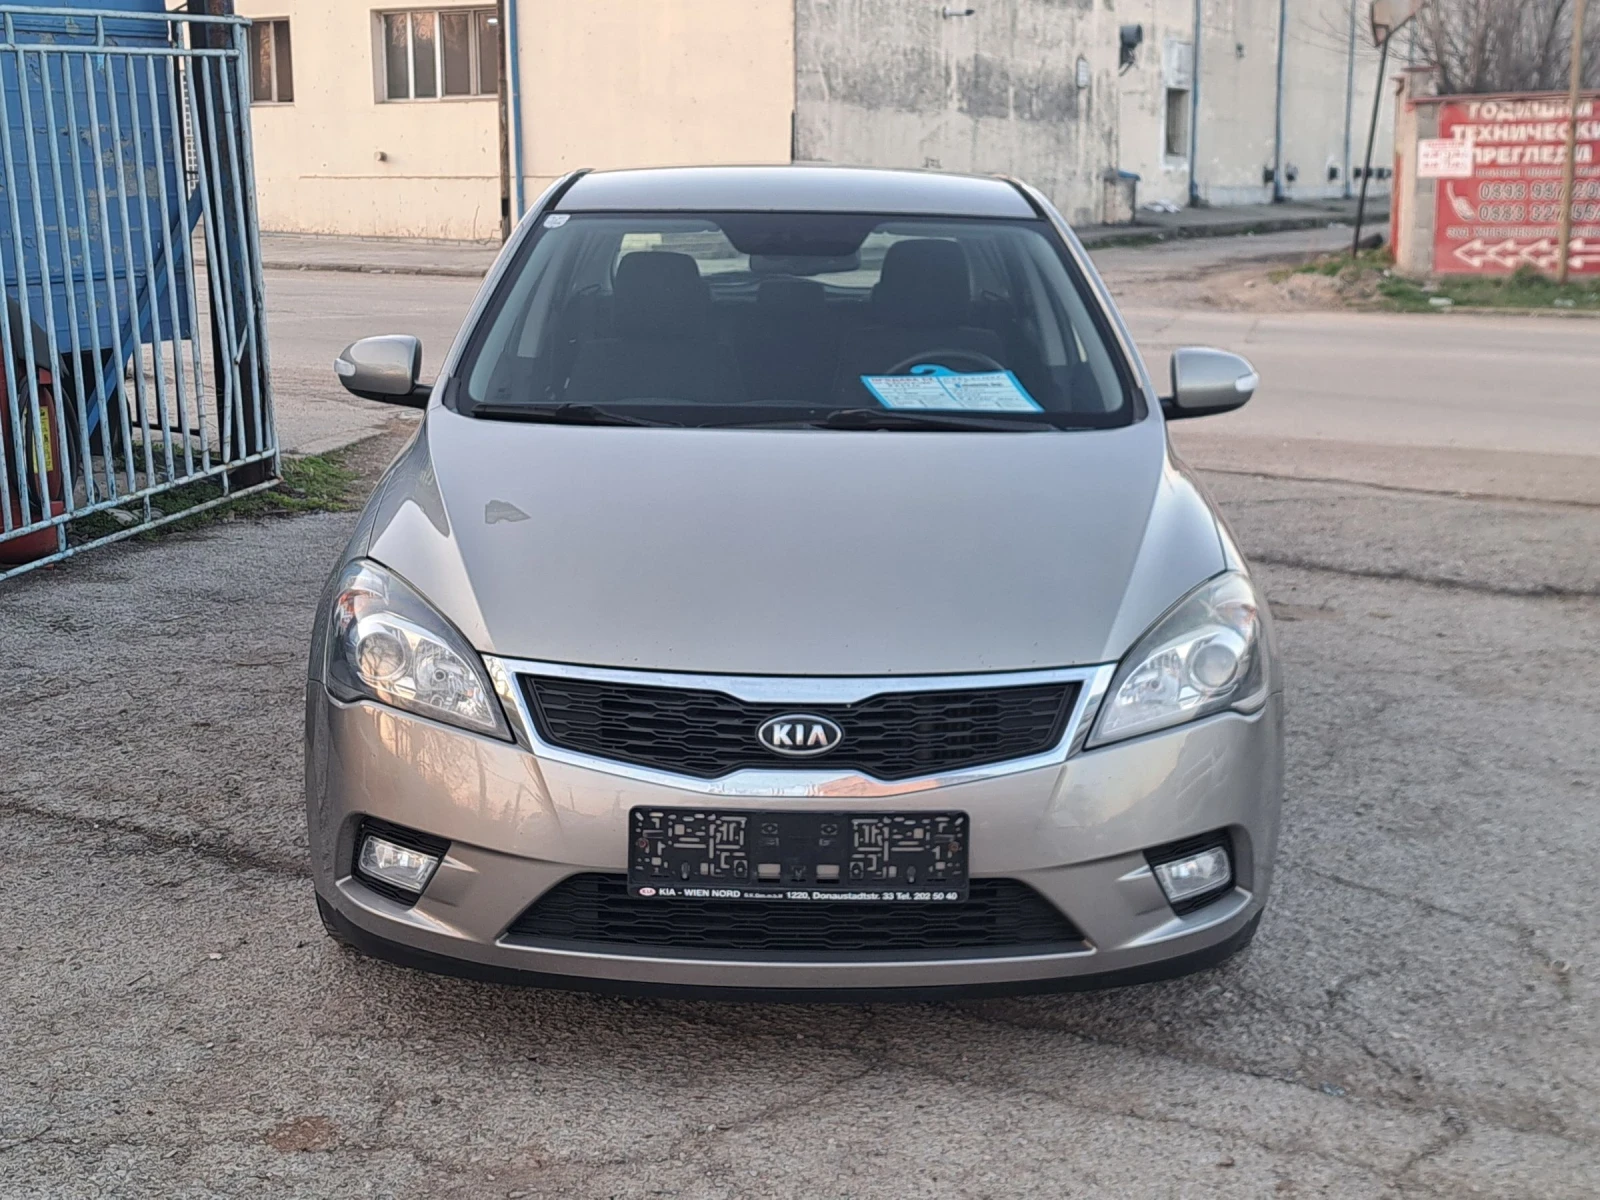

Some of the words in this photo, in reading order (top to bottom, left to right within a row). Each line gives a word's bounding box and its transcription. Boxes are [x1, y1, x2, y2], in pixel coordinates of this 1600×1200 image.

[773, 723, 829, 746] KIA
[658, 887, 676, 897] KIA
[683, 888, 710, 898] WIEN
[711, 889, 741, 898] NORD
[786, 891, 811, 901] 1220,
[882, 891, 895, 900] 33
[896, 891, 912, 901] Tel.
[913, 892, 931, 901] 202
[932, 892, 945, 901] 50
[945, 892, 958, 901] 40
